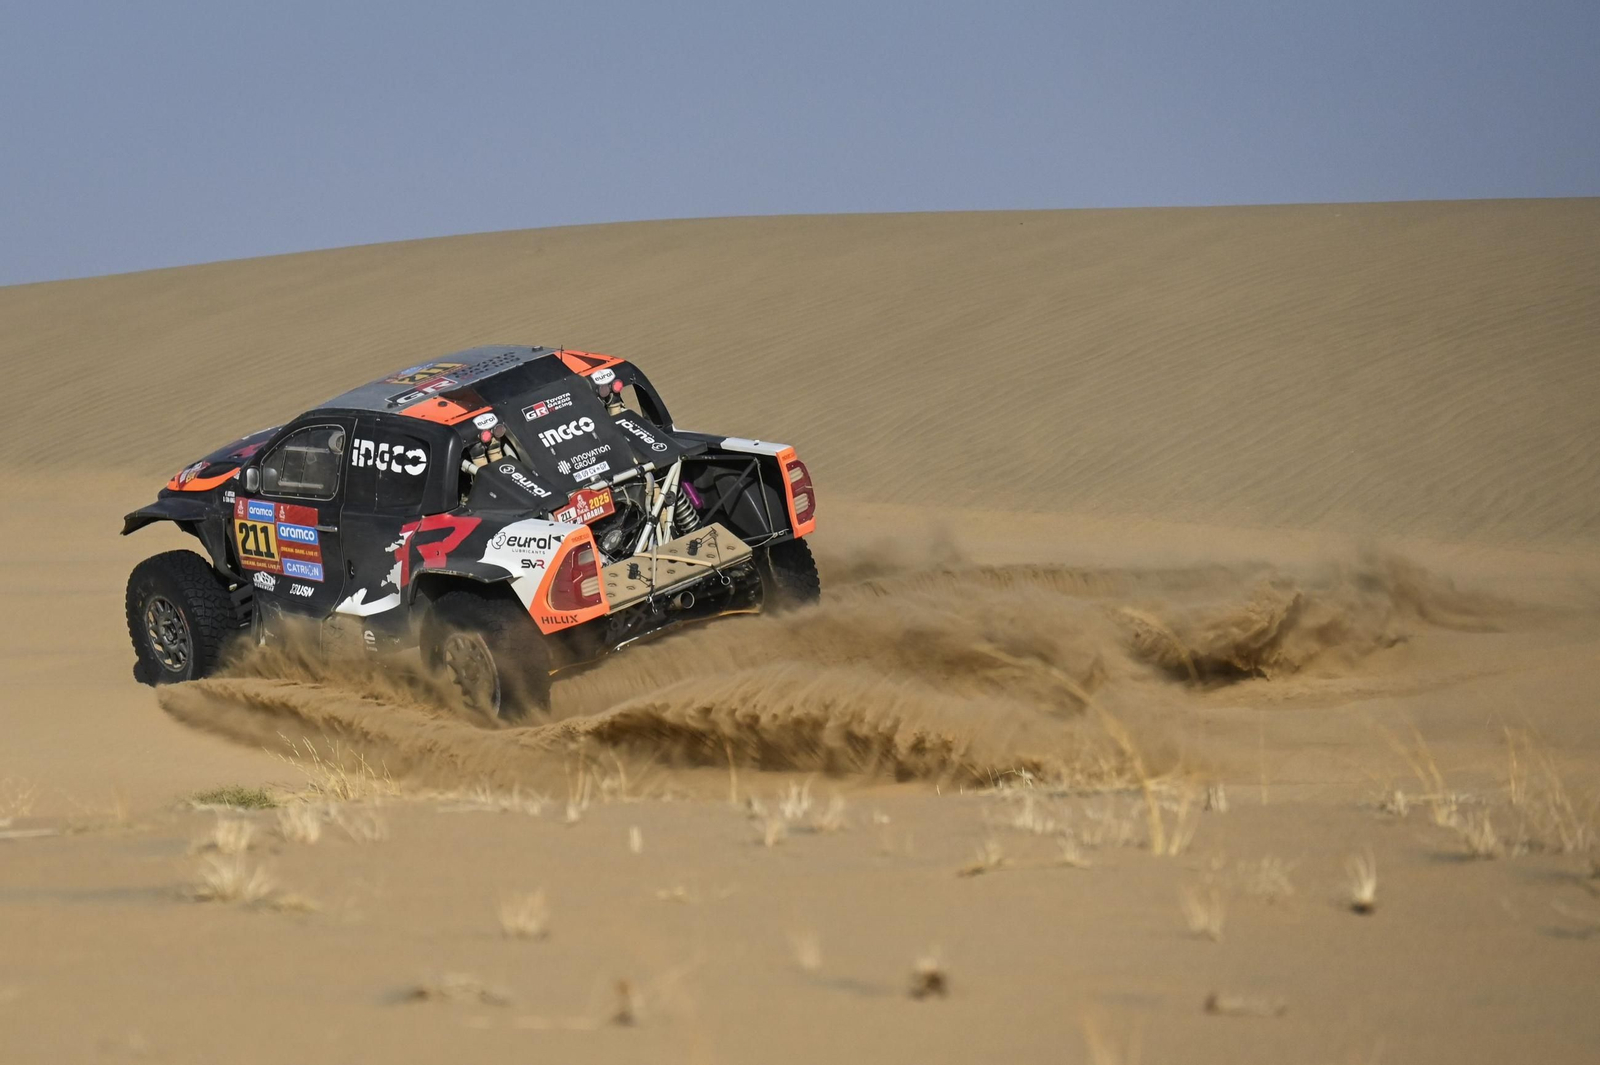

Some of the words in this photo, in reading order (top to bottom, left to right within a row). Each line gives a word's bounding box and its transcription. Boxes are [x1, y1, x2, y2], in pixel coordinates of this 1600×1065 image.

[594, 371, 614, 382] eurol
[396, 380, 451, 403] GR
[546, 392, 571, 404] TOYOTA
[525, 406, 549, 420] GR
[476, 415, 496, 427] eurol
[615, 419, 655, 444] eurol
[574, 456, 597, 470] GROUP
[511, 472, 552, 498] eurol
[589, 492, 610, 510] 2025
[249, 505, 273, 517] aramco
[560, 511, 572, 522] 211
[583, 506, 605, 522] ARABIA
[238, 522, 276, 559] 211
[280, 526, 315, 541] aramco
[506, 534, 552, 550] eurol
[521, 558, 545, 569] SVR
[297, 584, 314, 597] USN
[541, 614, 578, 624] HILUX
